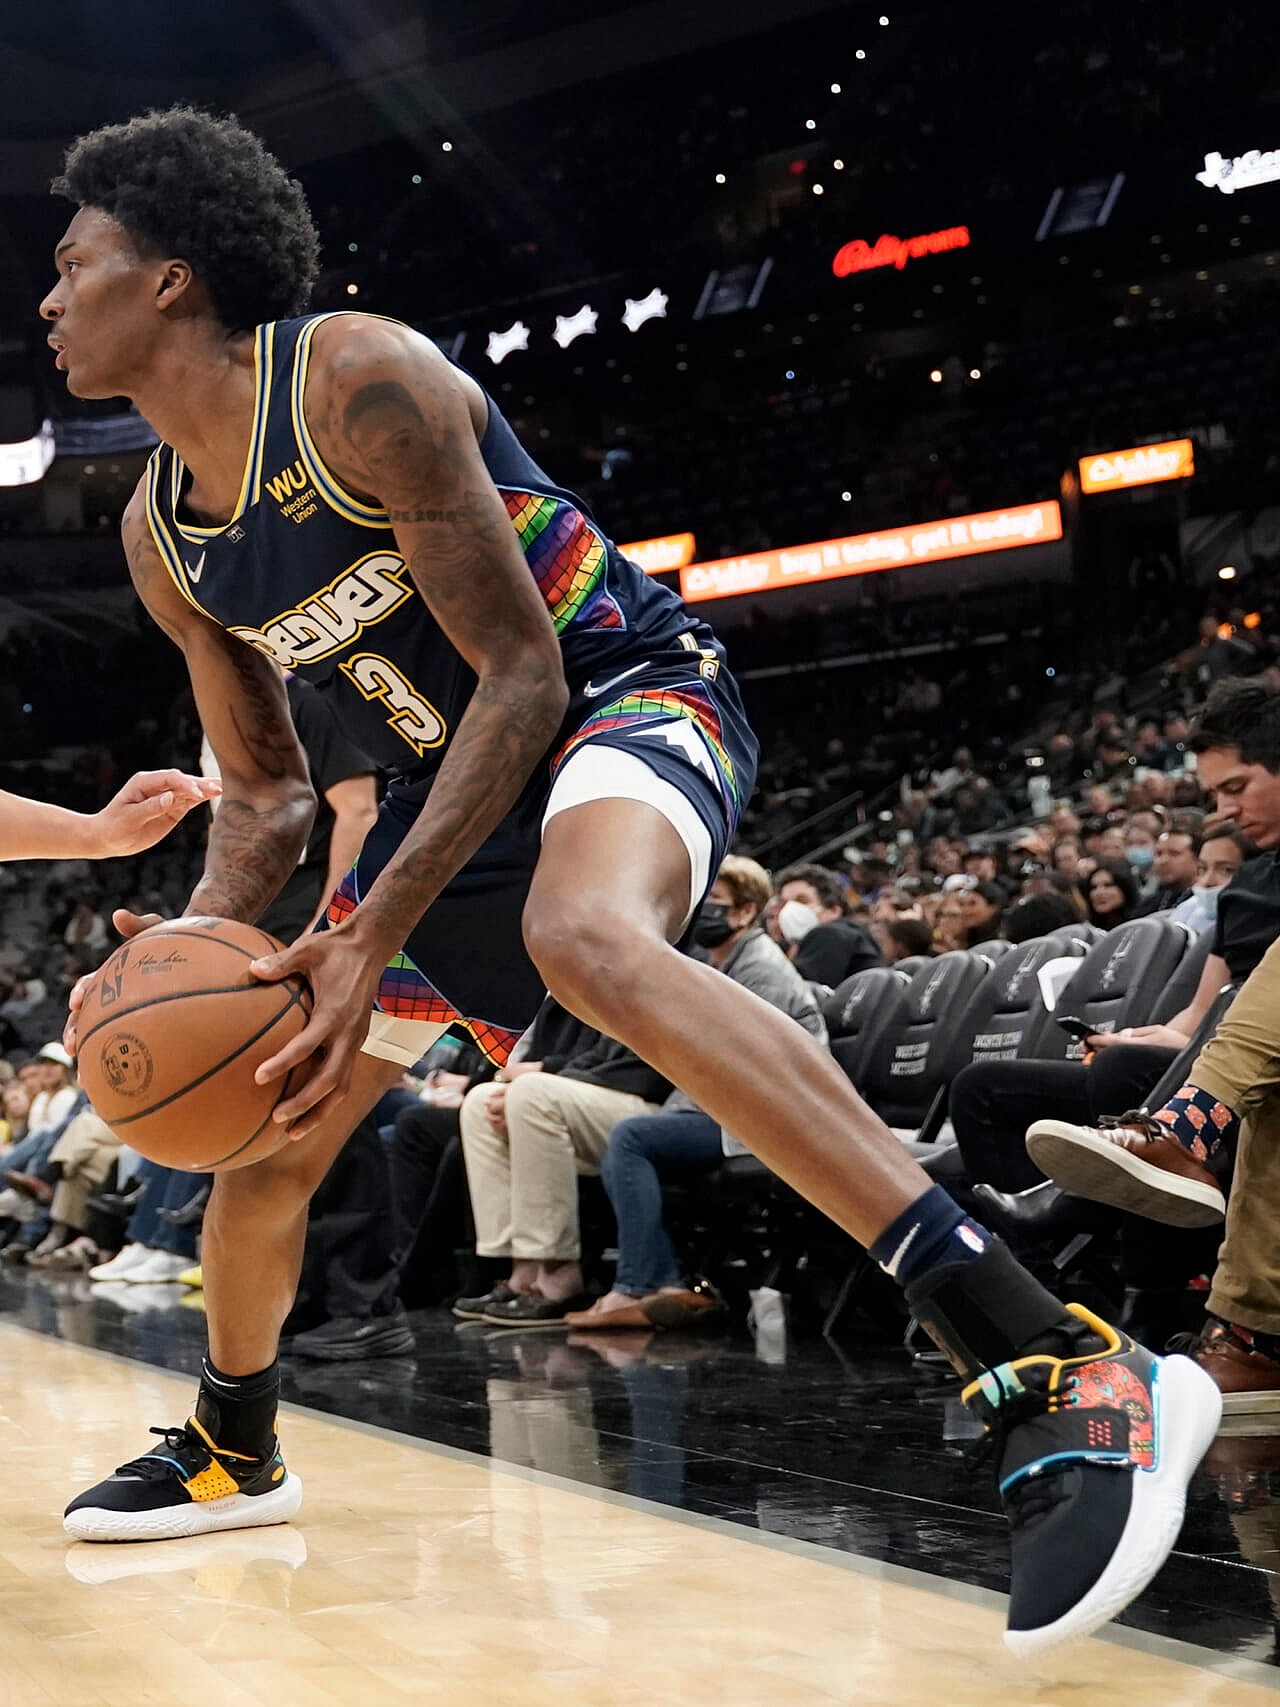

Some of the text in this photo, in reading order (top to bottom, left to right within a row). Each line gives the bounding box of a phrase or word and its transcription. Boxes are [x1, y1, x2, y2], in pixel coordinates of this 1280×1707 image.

[264, 460, 308, 504] WU
[279, 488, 317, 518] Western
[291, 503, 319, 525] Union
[342, 654, 445, 754] 3
